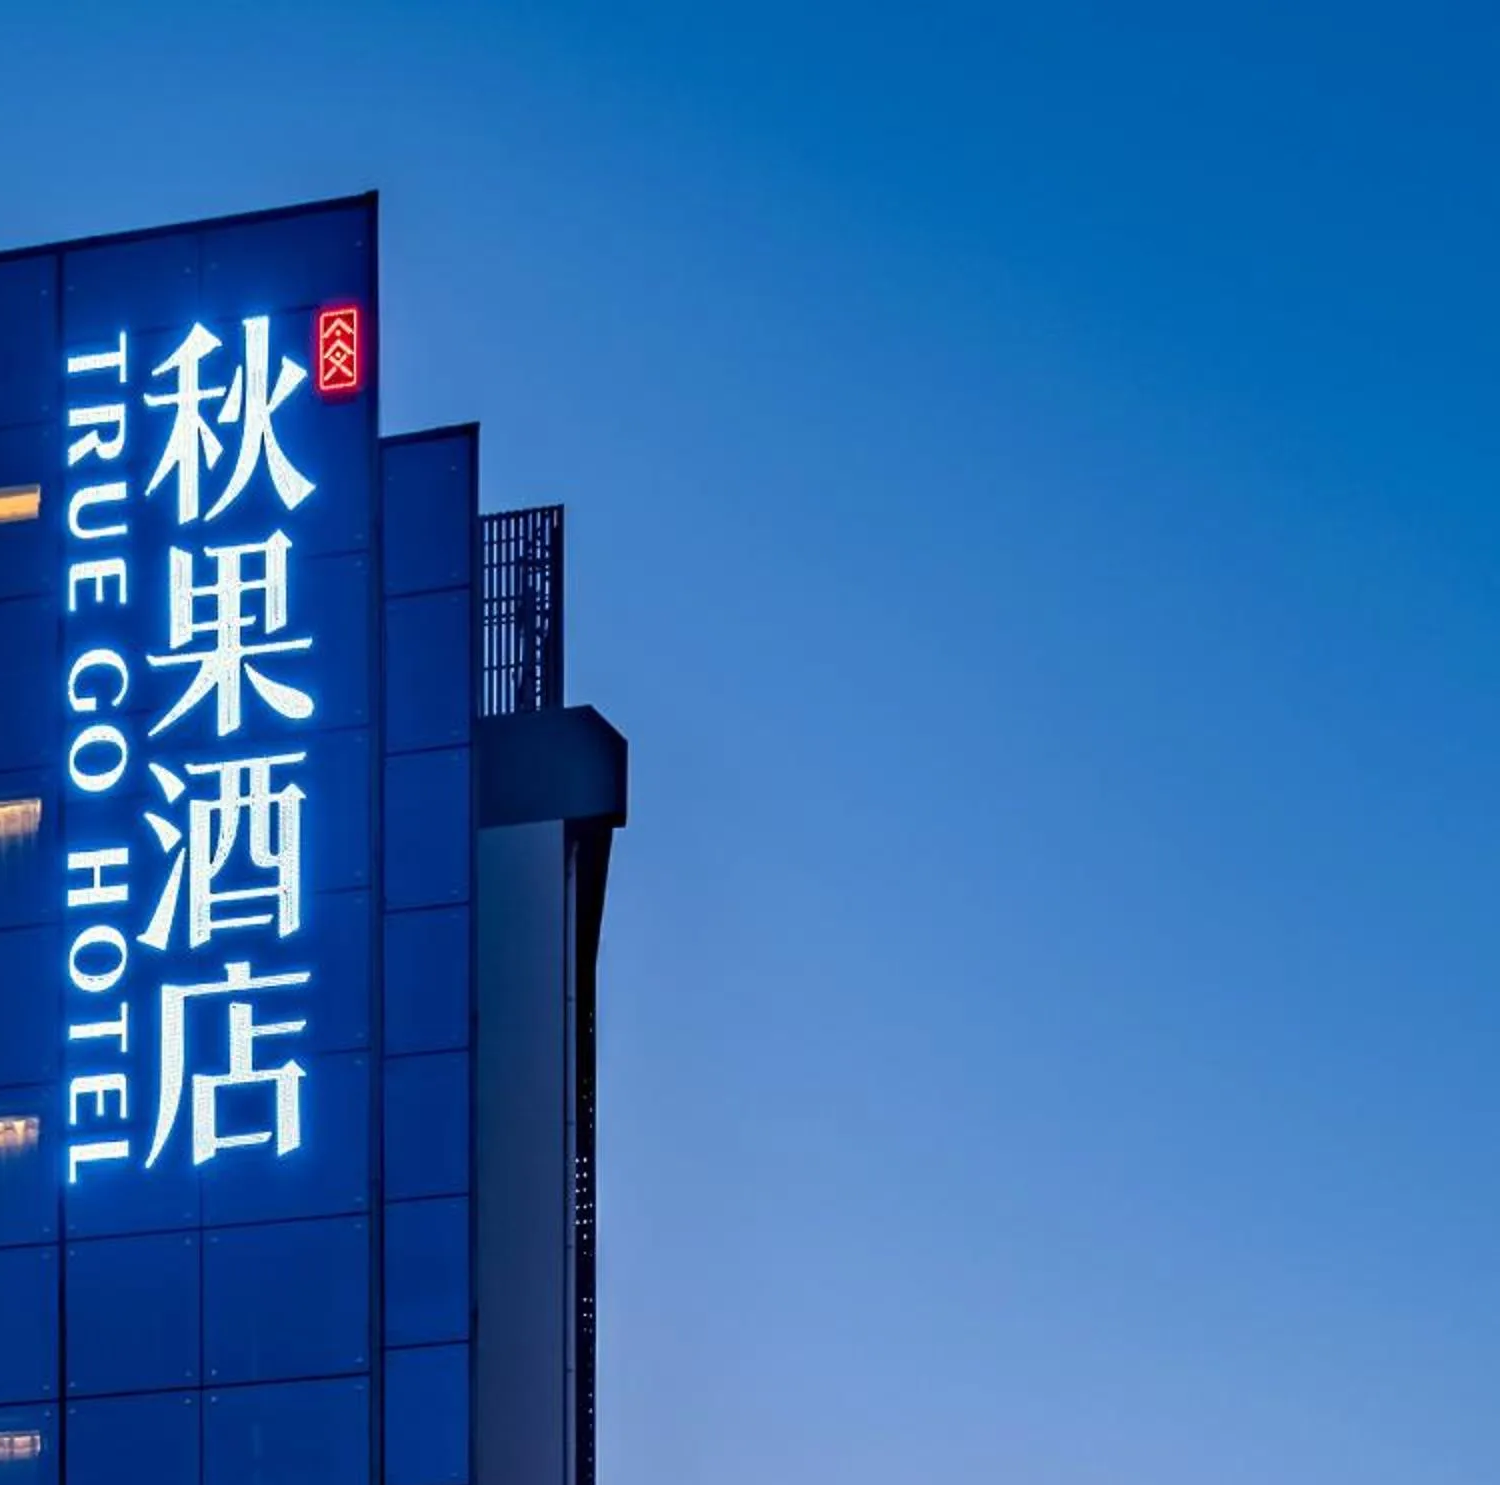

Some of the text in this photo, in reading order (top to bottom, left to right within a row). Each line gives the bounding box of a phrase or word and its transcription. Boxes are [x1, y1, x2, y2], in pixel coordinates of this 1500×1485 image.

[67, 330, 129, 1184] TRUE GO HOTEL
[137, 315, 316, 1169] 秋果酒店
